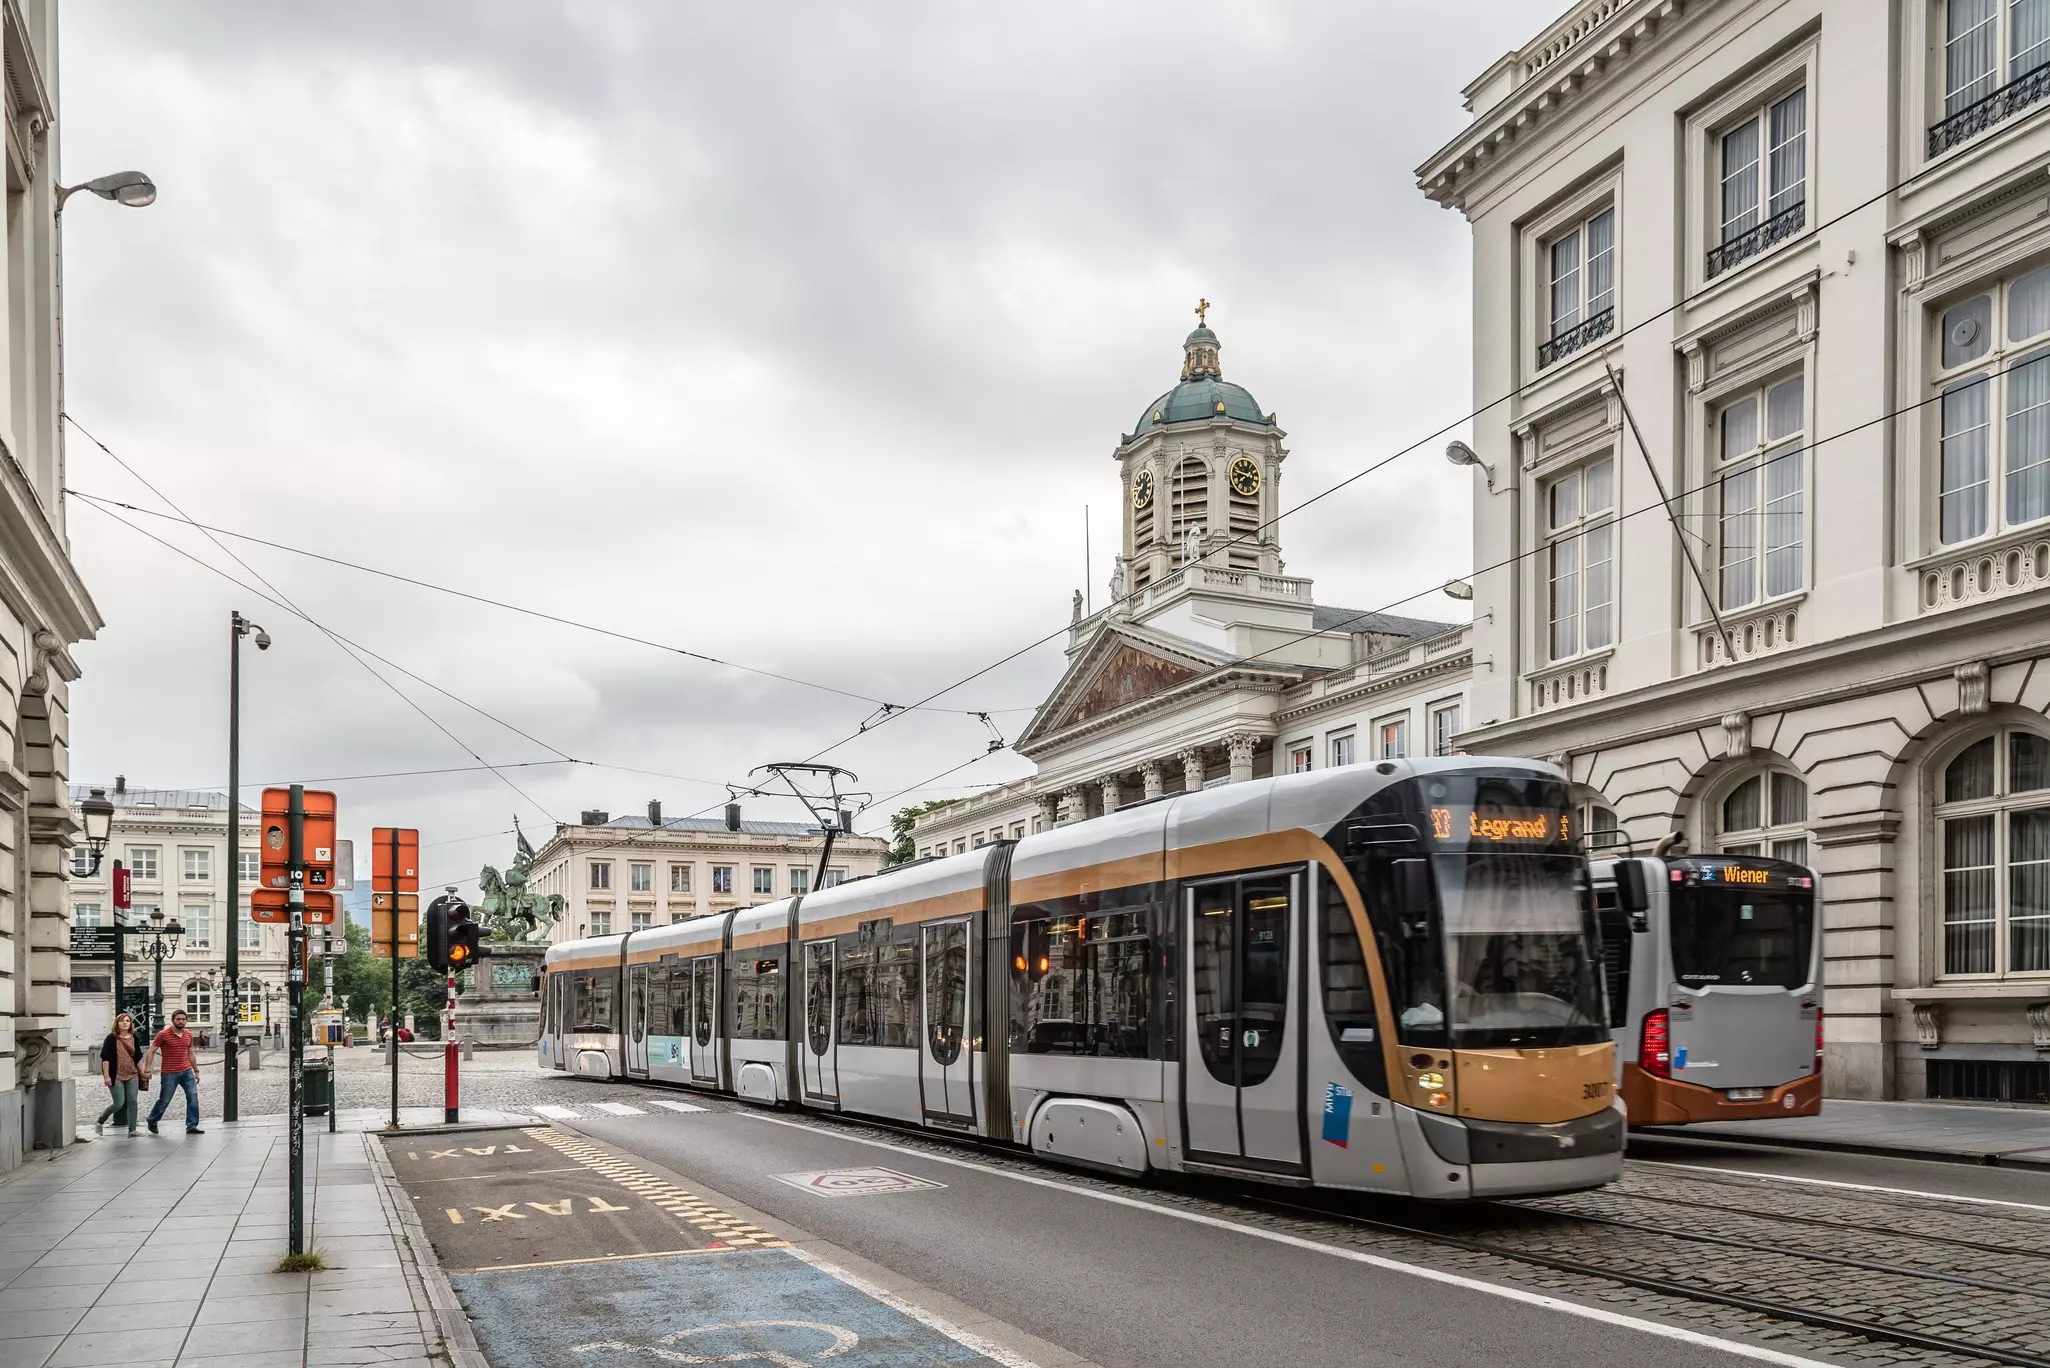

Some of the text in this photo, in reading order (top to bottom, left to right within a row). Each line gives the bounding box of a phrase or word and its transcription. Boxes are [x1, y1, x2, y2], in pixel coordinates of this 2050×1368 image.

[1469, 811, 1546, 840] Legrand
[1724, 866, 1769, 884] Wiener
[407, 1144, 533, 1161] TAXI
[445, 1196, 631, 1225] TAXI
